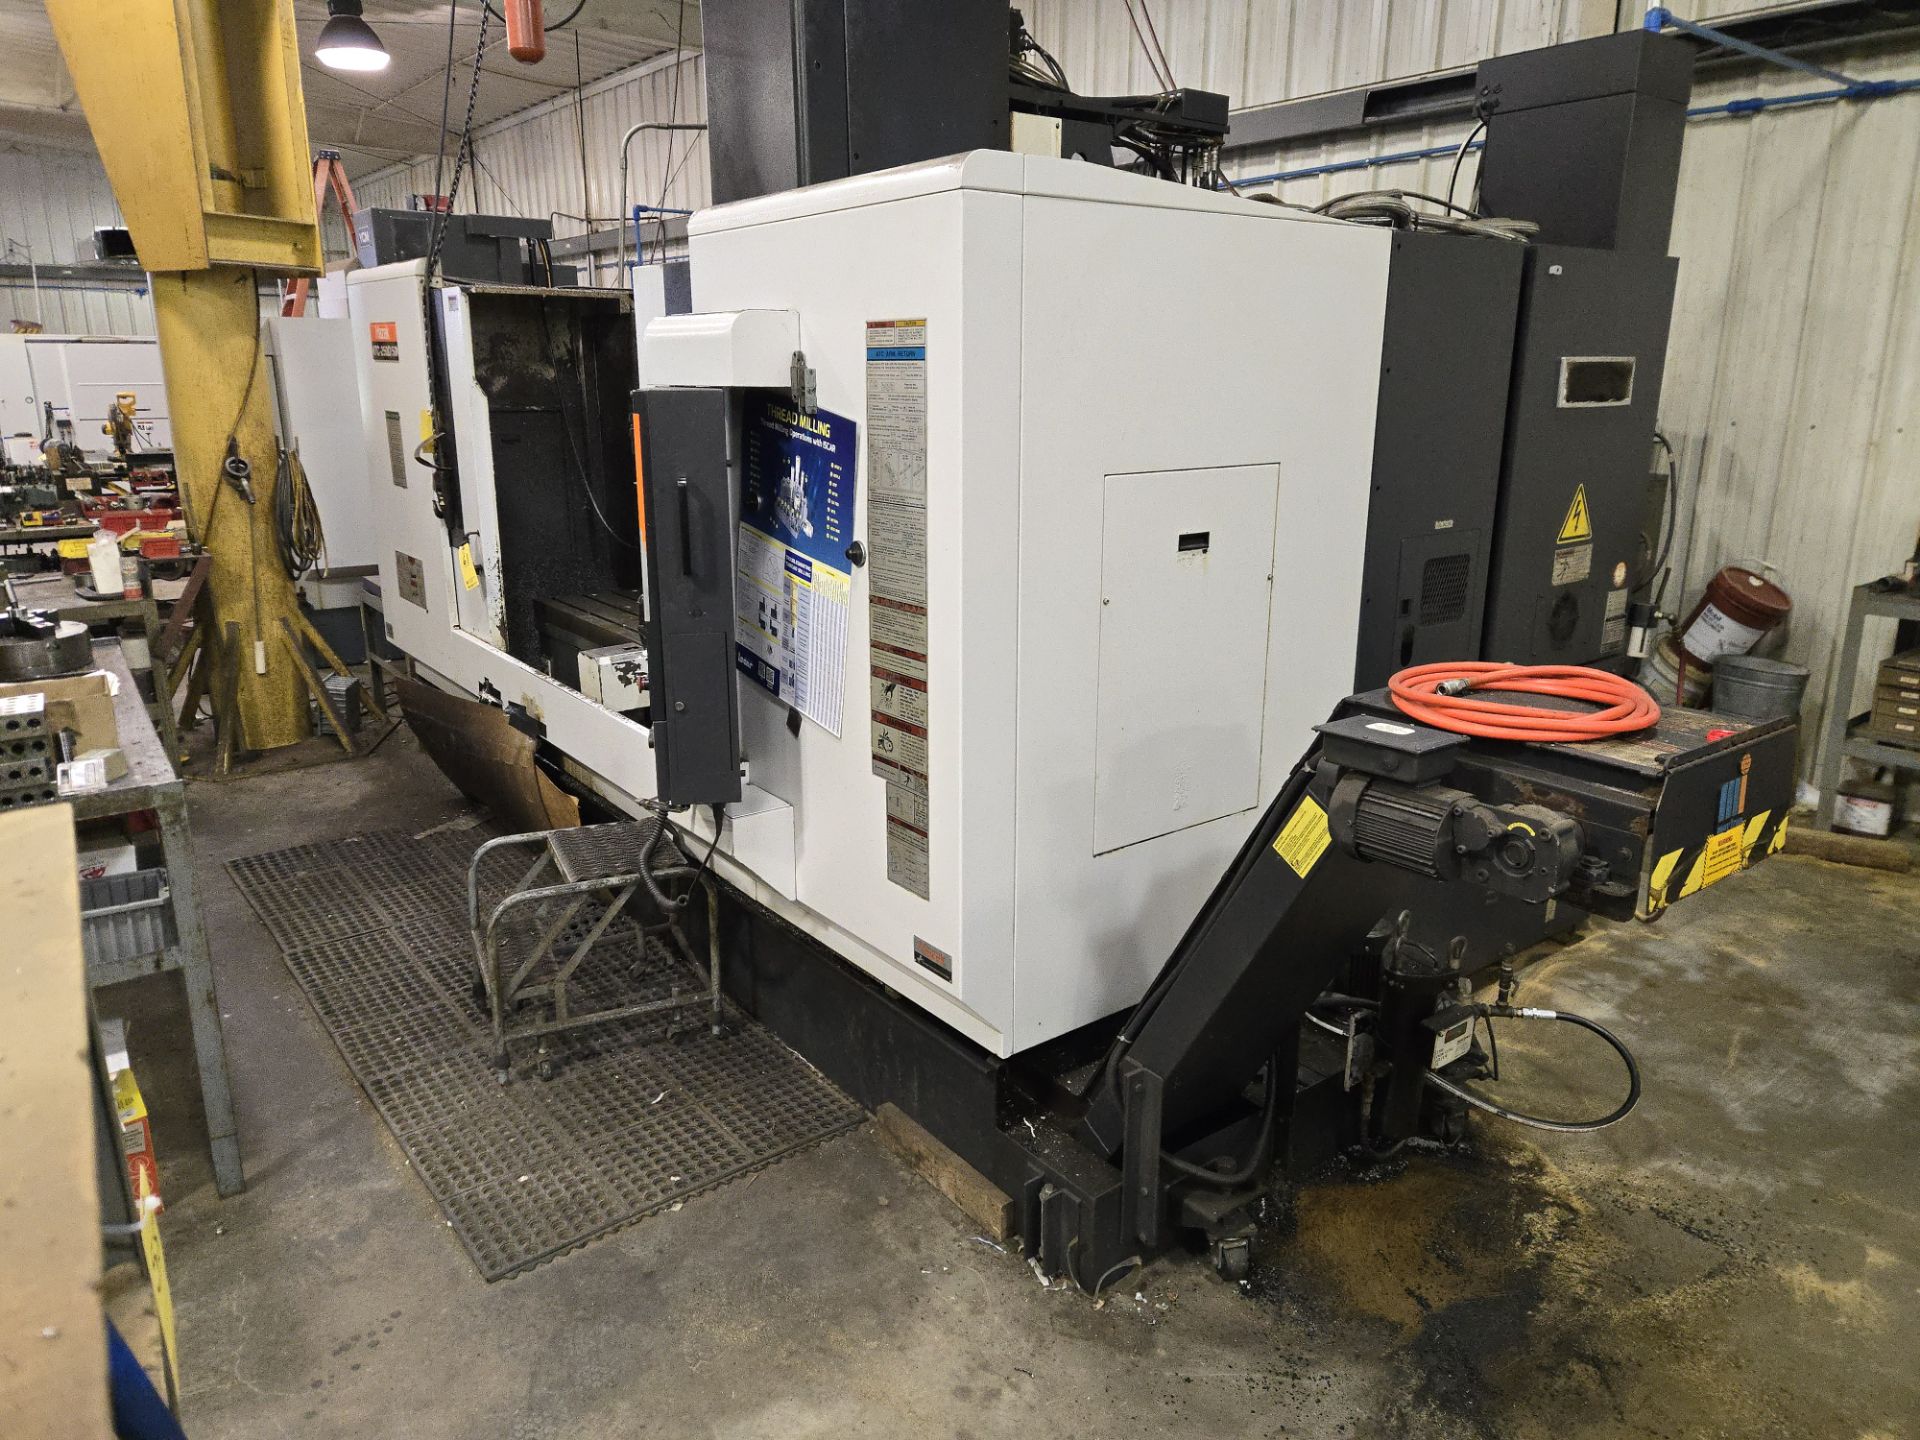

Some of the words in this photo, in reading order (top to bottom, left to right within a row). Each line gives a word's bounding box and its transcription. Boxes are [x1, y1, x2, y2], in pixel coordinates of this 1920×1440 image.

[767, 403, 798, 426] THREAD
[799, 414, 831, 438] MILLING
[790, 428, 812, 444] Operations
[813, 438, 822, 448] with
